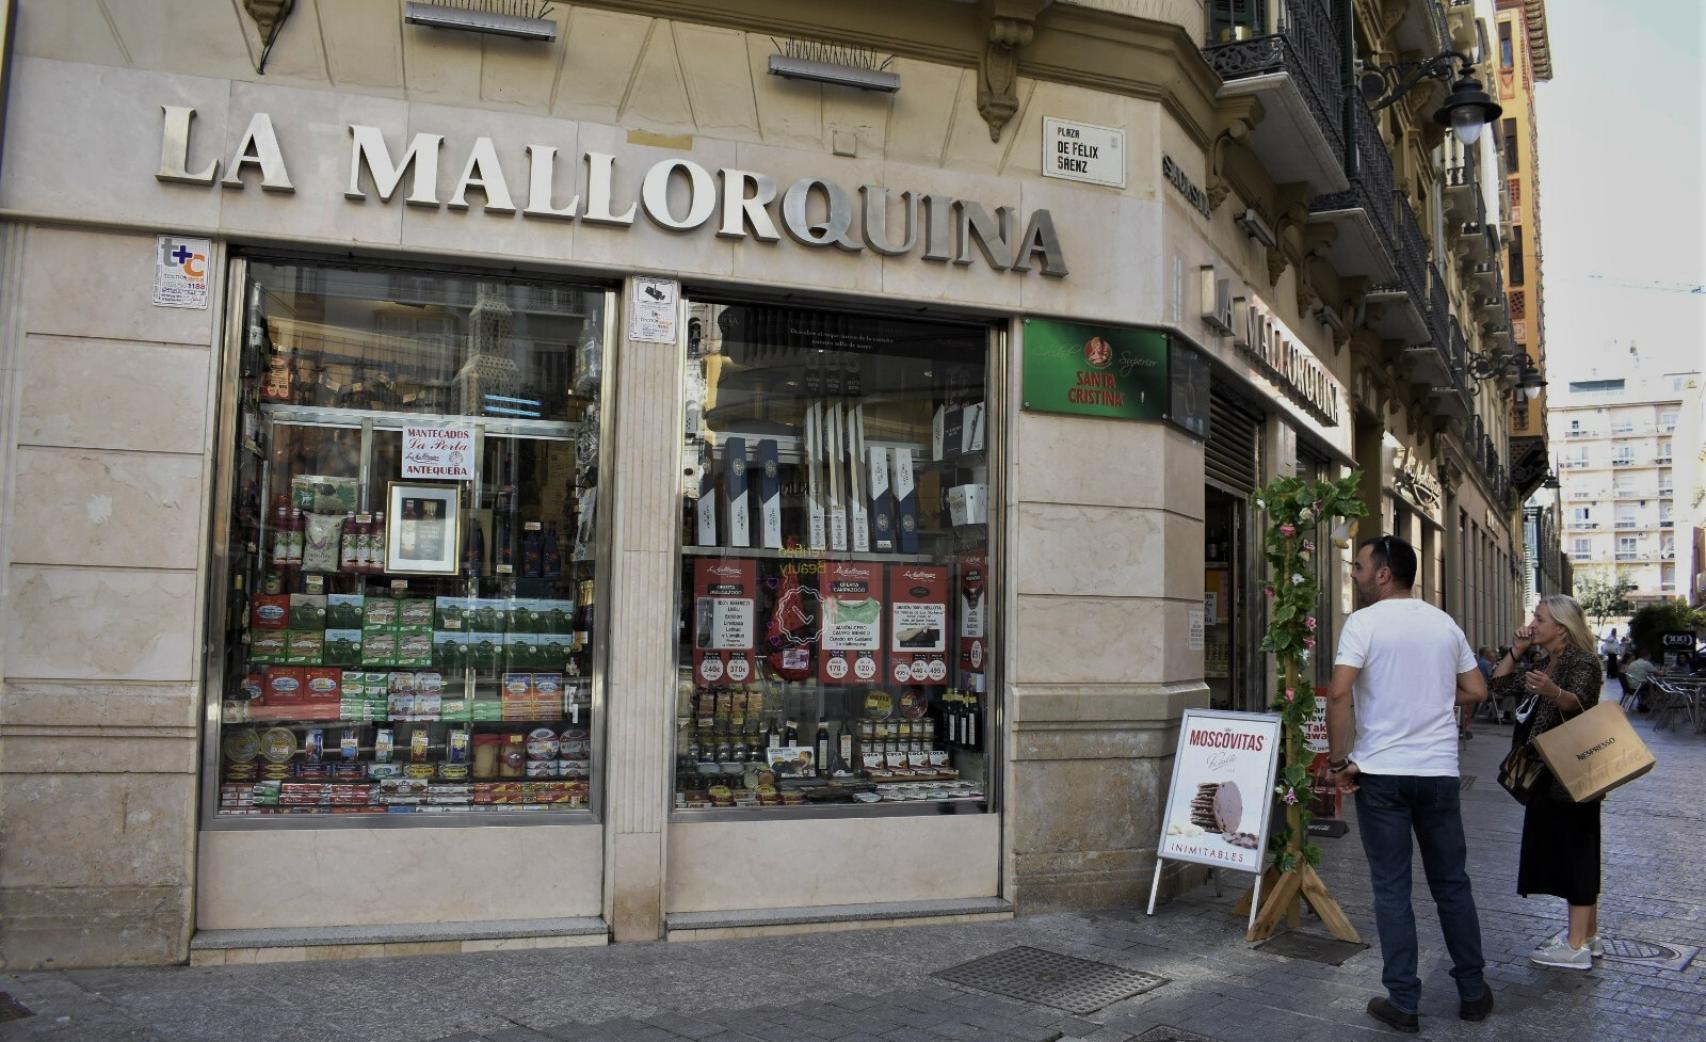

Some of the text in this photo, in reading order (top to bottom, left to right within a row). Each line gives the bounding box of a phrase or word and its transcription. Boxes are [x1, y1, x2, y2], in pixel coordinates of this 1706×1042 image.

[1057, 126, 1080, 139] PLAZA
[1057, 140, 1070, 155] DE
[1072, 141, 1099, 160] FÉLIX
[154, 104, 1069, 279] LA MALLORQUINA
[1077, 370, 1116, 388] SANTA
[1068, 387, 1126, 408] CRISTINA
[407, 428, 469, 439] MANTECADOS
[407, 466, 468, 476] ANTEQUERA
[1305, 732, 1328, 740] awa
[1307, 723, 1327, 732] Tak
[1575, 737, 1616, 761] NESPRESSO
[1171, 842, 1244, 863] INIMITABLES
